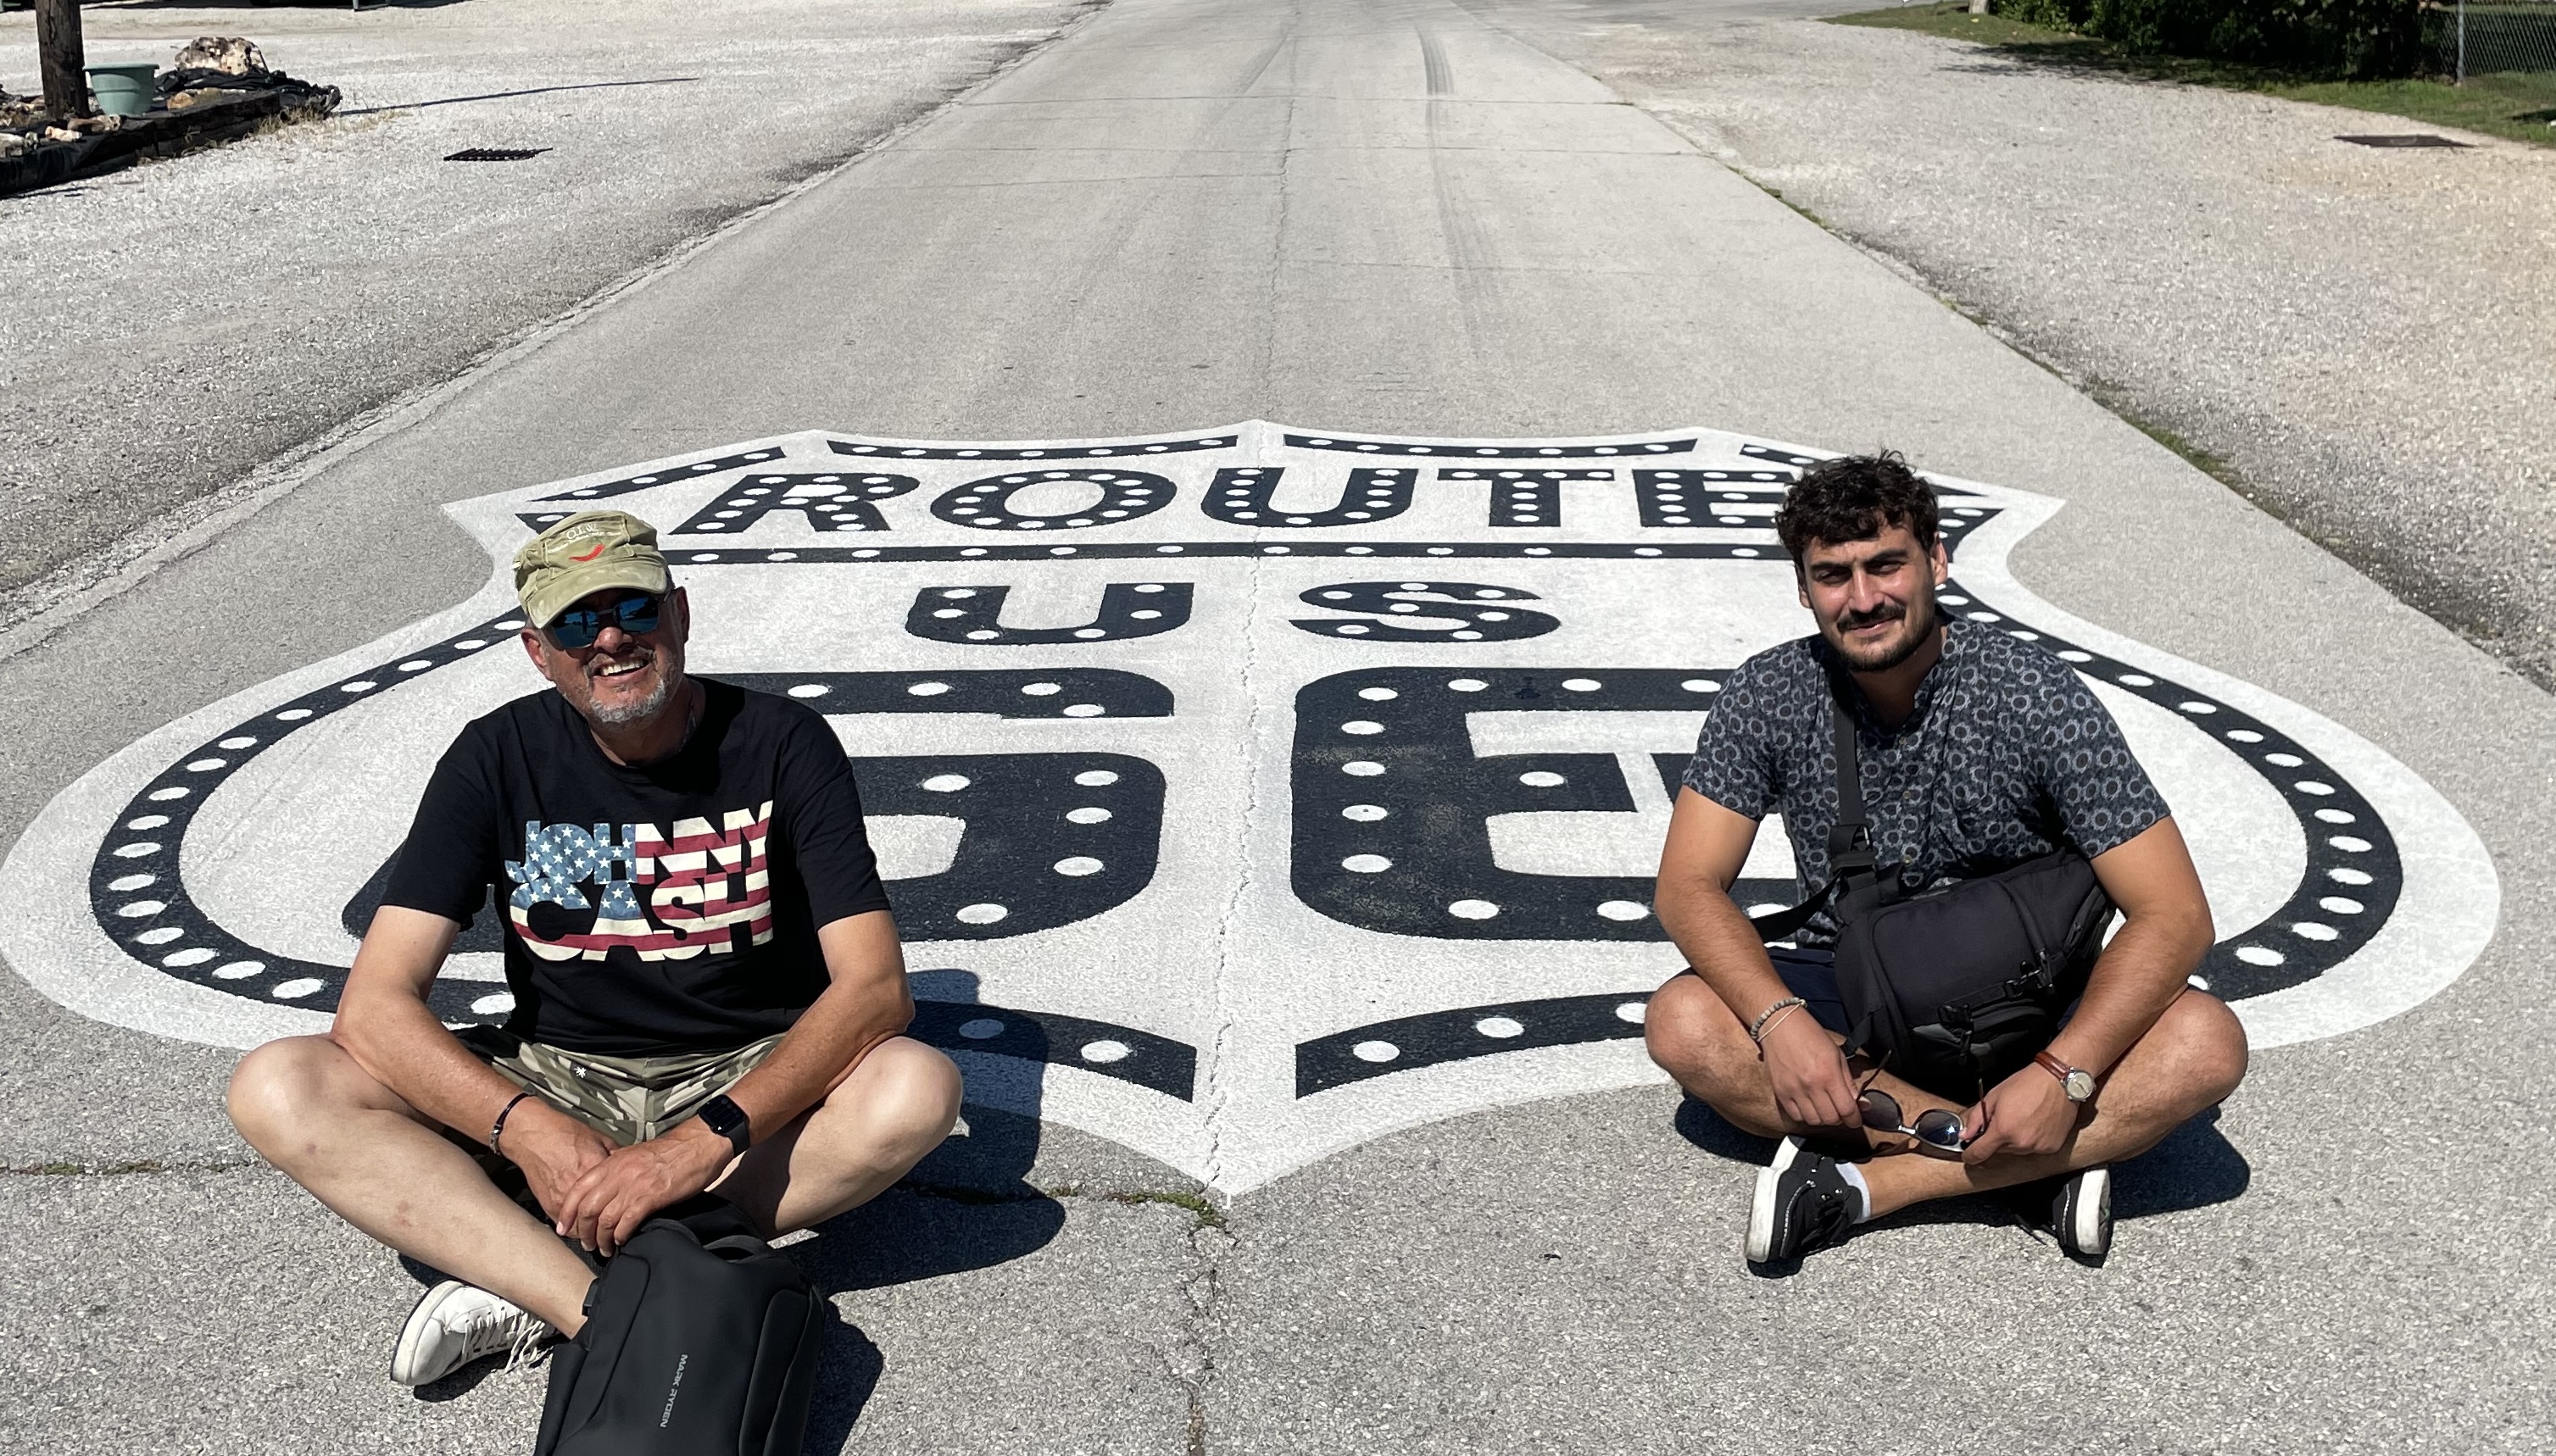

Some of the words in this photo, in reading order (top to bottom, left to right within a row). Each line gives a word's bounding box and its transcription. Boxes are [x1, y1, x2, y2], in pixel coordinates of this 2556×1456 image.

[668, 467, 1792, 536] ROUTE
[905, 581, 1562, 647] US
[504, 799, 773, 885] JOHNNY
[510, 873, 773, 961] CASH
[672, 1354, 688, 1387] MARK
[660, 1388, 678, 1428] RYDEN
